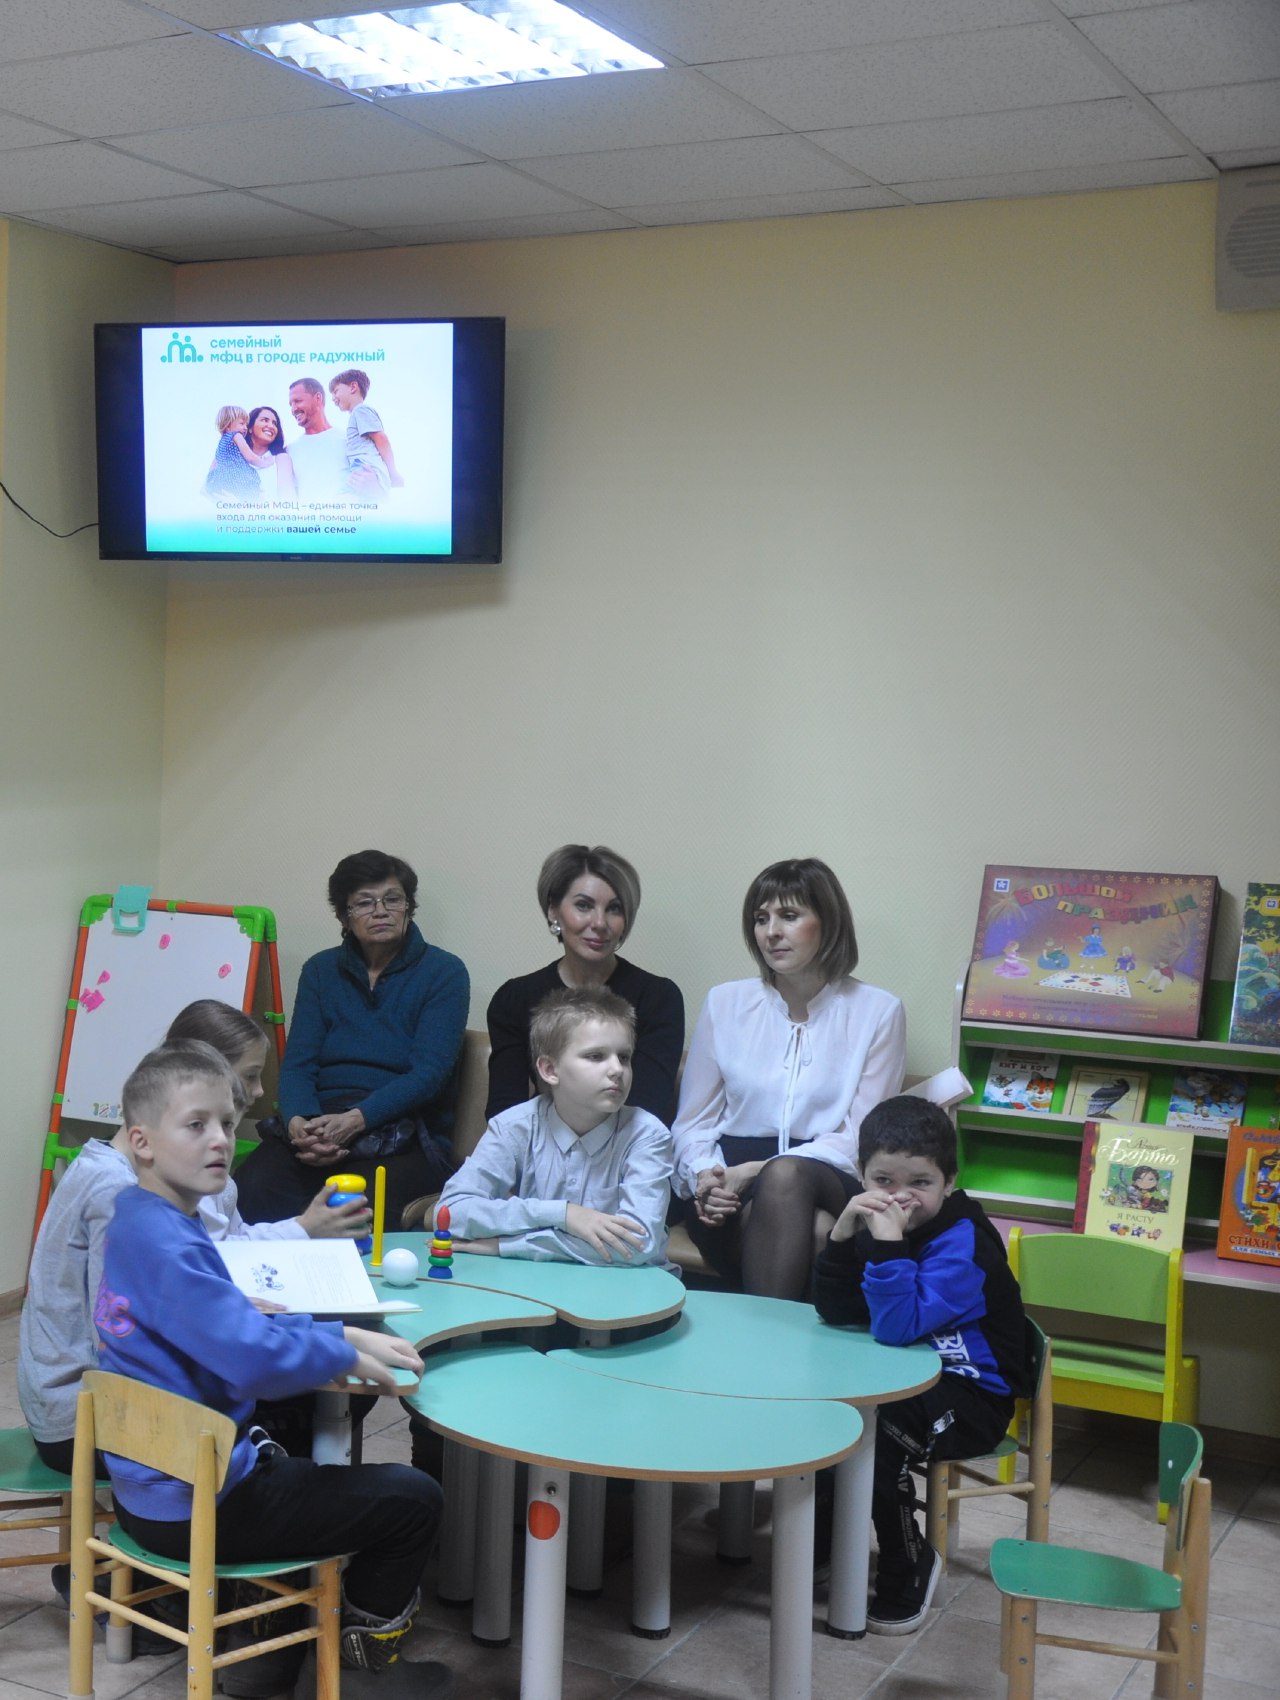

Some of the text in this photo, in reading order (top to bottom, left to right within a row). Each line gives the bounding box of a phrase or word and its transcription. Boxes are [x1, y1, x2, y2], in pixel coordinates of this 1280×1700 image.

[210, 335, 282, 348] семейный
[210, 350, 243, 364] мфц
[257, 352, 306, 364] ГОРОДЕ
[309, 349, 386, 363] РАДУЖНЫЙ
[216, 501, 270, 510] Семейный
[272, 501, 300, 511] МФЦ
[309, 502, 347, 511] единая
[349, 502, 379, 510] точка
[216, 514, 362, 523] входа для оказания помощи
[216, 524, 357, 534] и поддержки вашей семье
[1056, 894, 1198, 925] ПРАЗДНИК
[1097, 1137, 1182, 1168] Барто
[1125, 1213, 1155, 1224] РАСТУ
[1229, 1235, 1270, 1249] СТИХИ
